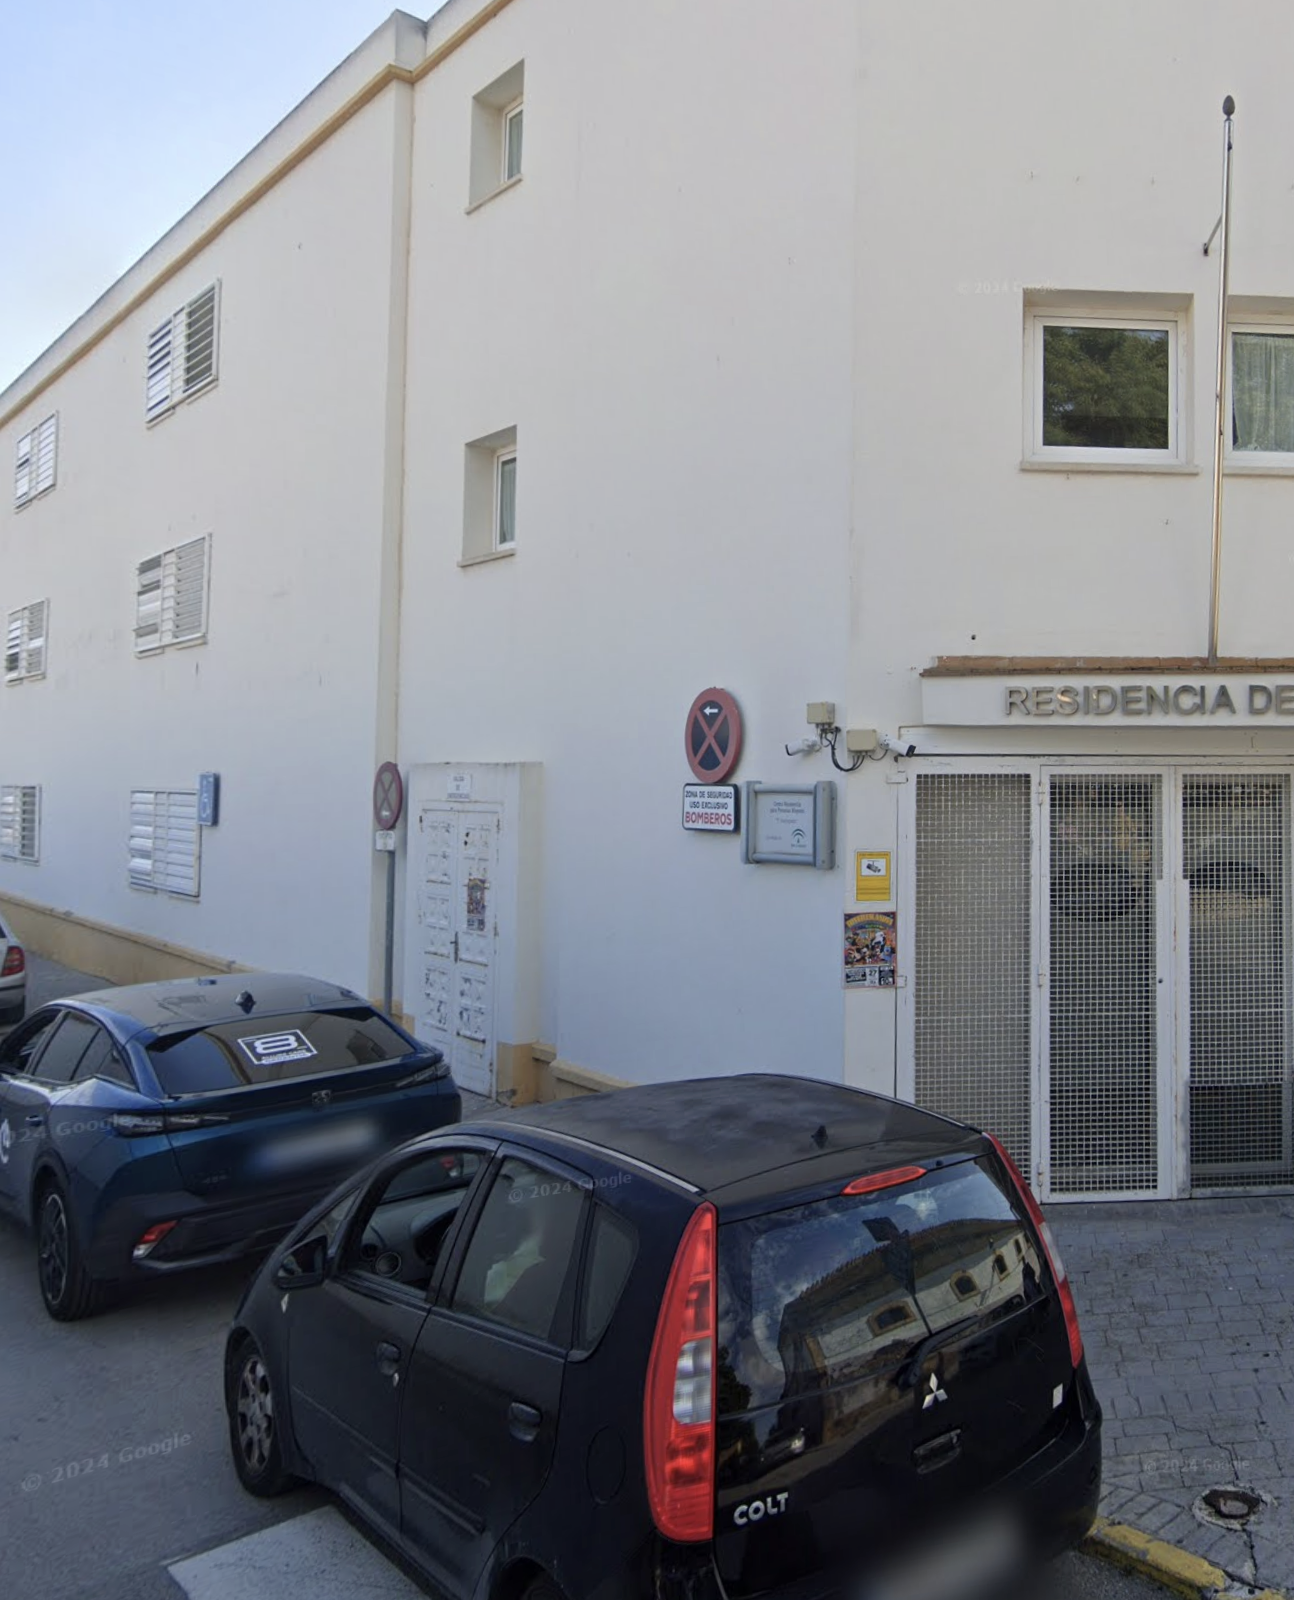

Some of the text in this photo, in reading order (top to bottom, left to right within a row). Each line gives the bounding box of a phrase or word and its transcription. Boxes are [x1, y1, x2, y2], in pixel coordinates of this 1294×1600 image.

[1004, 684, 1237, 716] RESIDENCIA
[685, 790, 733, 799] ZONA DE SEGURIDAD
[689, 801, 729, 810] USO EXCLUSIVO
[685, 811, 733, 826] BOMBEROS
[733, 1491, 789, 1526] COLT
